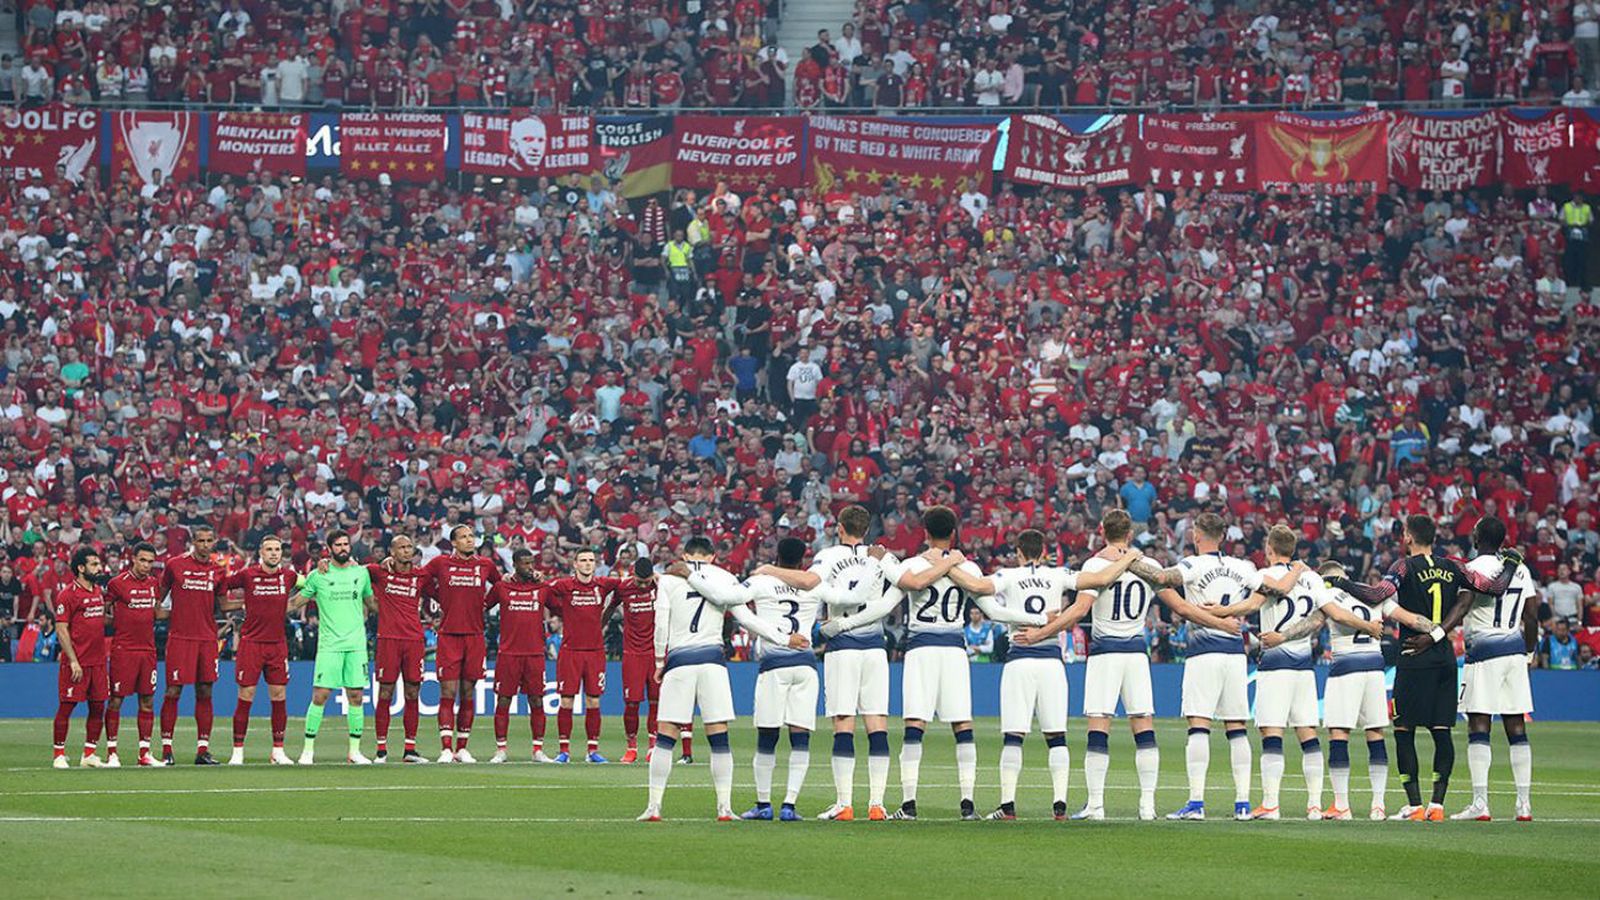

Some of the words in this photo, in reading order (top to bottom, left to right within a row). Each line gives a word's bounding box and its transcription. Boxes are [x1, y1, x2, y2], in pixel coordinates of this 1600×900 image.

[62, 110, 97, 130] FC
[342, 112, 379, 122] FORZA
[384, 113, 443, 123] LIVERPOOL
[463, 114, 484, 129] WE
[486, 116, 510, 131] ARE
[561, 116, 591, 131] THIS
[1161, 119, 1180, 130] THE
[1185, 121, 1237, 132] PRESENCE
[1411, 111, 1499, 138] LIVERPOOL
[216, 125, 299, 140] MENTALITY
[342, 127, 379, 137] FORZA
[384, 127, 443, 138] LIVERPOOL
[464, 132, 486, 147] HIS
[601, 128, 663, 147] ENGLISH
[681, 132, 772, 150] LIVERPOOL
[774, 135, 796, 149] FC
[861, 121, 910, 140] EMPIRE
[913, 126, 992, 144] CONQUERED
[218, 140, 296, 155] MONSTERS
[353, 143, 390, 153] ALLEZ
[394, 143, 432, 153] ALLEZ
[551, 136, 564, 150] IS
[567, 134, 589, 148] HIS
[815, 134, 830, 150] BY
[833, 137, 857, 154] THE
[859, 142, 886, 157] RED
[887, 143, 899, 158] &
[901, 144, 942, 162] WHITE
[944, 147, 983, 164] ARMY
[1146, 141, 1159, 151] OF
[1162, 143, 1219, 156] GREATNESS
[1411, 139, 1460, 158] MAKE
[1464, 131, 1494, 155] THE
[1514, 132, 1563, 154] REDS
[464, 150, 508, 167] LEGACY
[545, 152, 590, 168] LEGEND
[676, 148, 732, 166] NEVER
[734, 153, 774, 167] GIVE
[775, 151, 798, 166] UP
[1419, 154, 1485, 175] PEOPLE
[1421, 167, 1479, 190] HAPPY
[1018, 577, 1052, 590] WINKS
[1417, 568, 1456, 584] LLORIS
[916, 585, 964, 623] 20
[1109, 580, 1146, 621] 10
[1427, 582, 1442, 625] 1
[1494, 587, 1524, 629] 17
[686, 591, 705, 634] 7
[777, 599, 800, 635] 3
